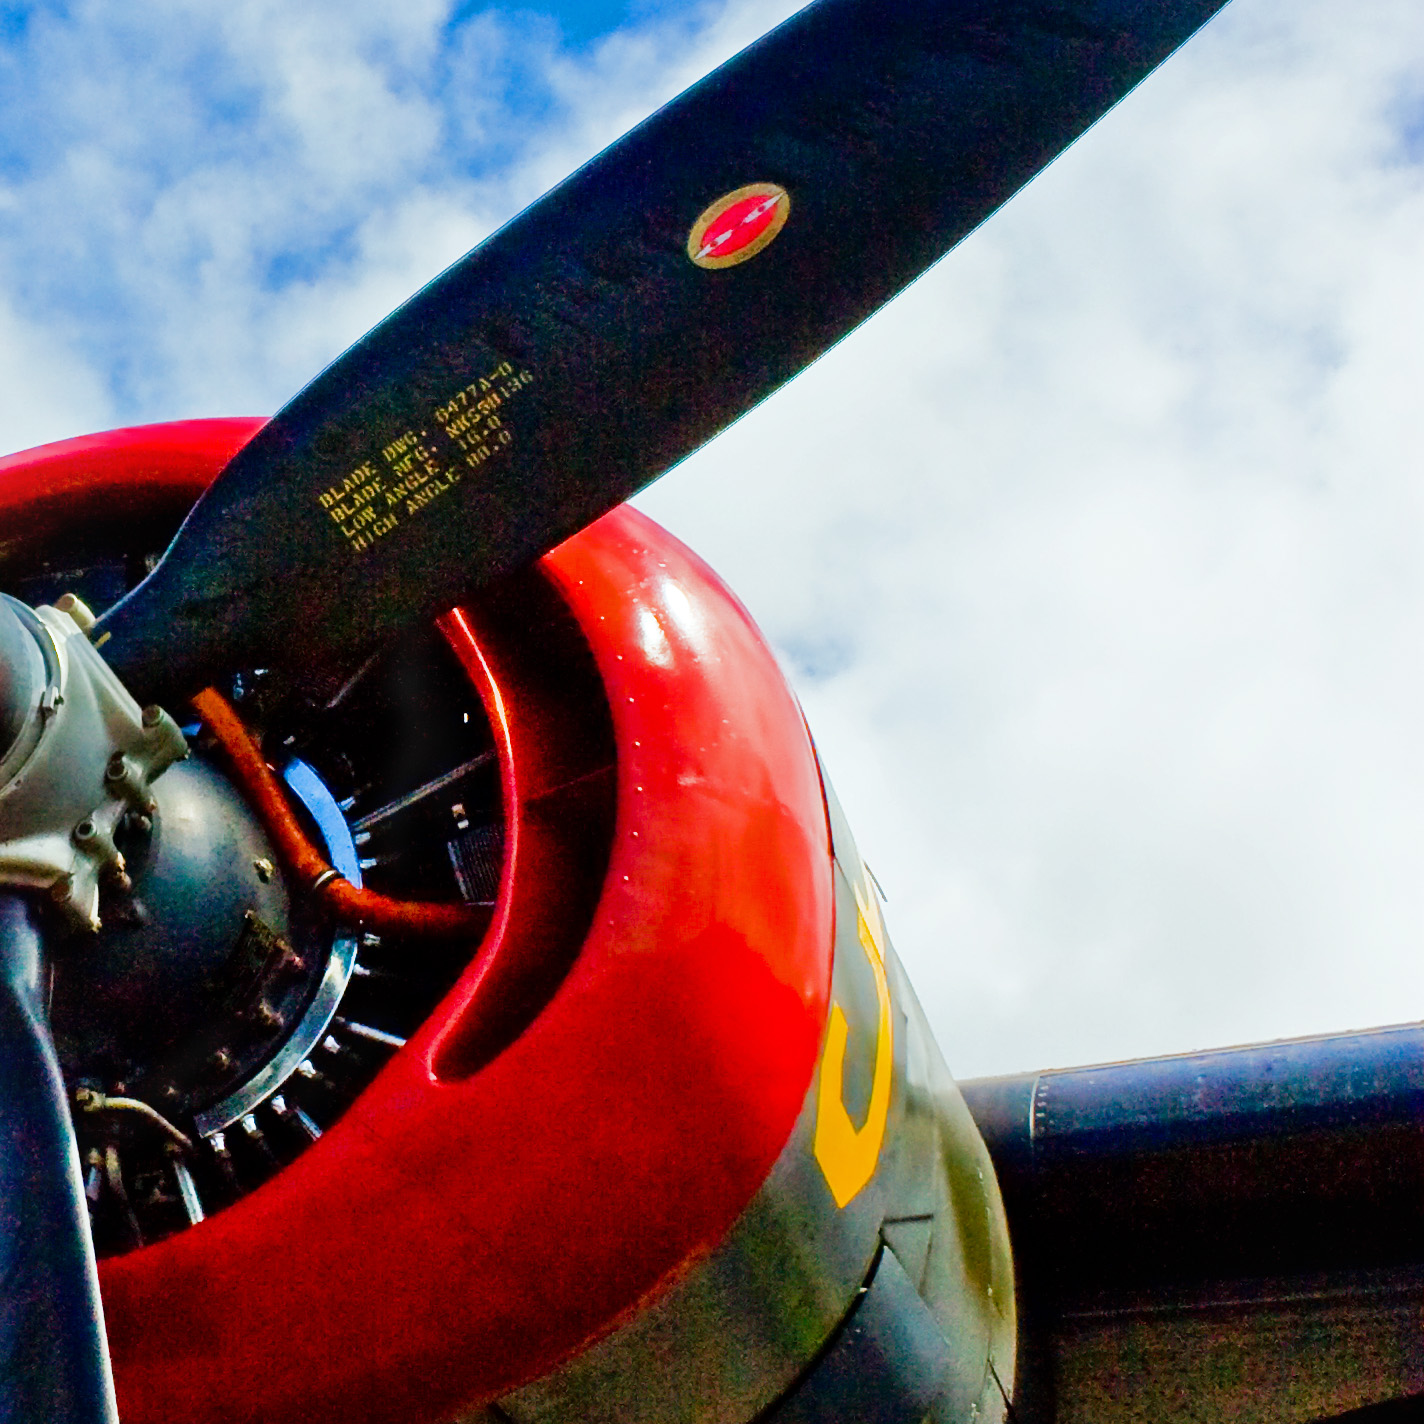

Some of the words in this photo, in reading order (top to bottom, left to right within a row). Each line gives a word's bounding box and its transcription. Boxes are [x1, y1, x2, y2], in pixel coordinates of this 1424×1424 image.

[319, 461, 376, 508] BLADE
[383, 431, 426, 461] DWG.
[331, 477, 386, 522] BLADE
[393, 446, 437, 477] MFG.
[341, 506, 376, 537] LOW
[386, 460, 439, 506] ANGLE
[352, 514, 398, 551] HIGH
[407, 468, 459, 514] ANGLE
